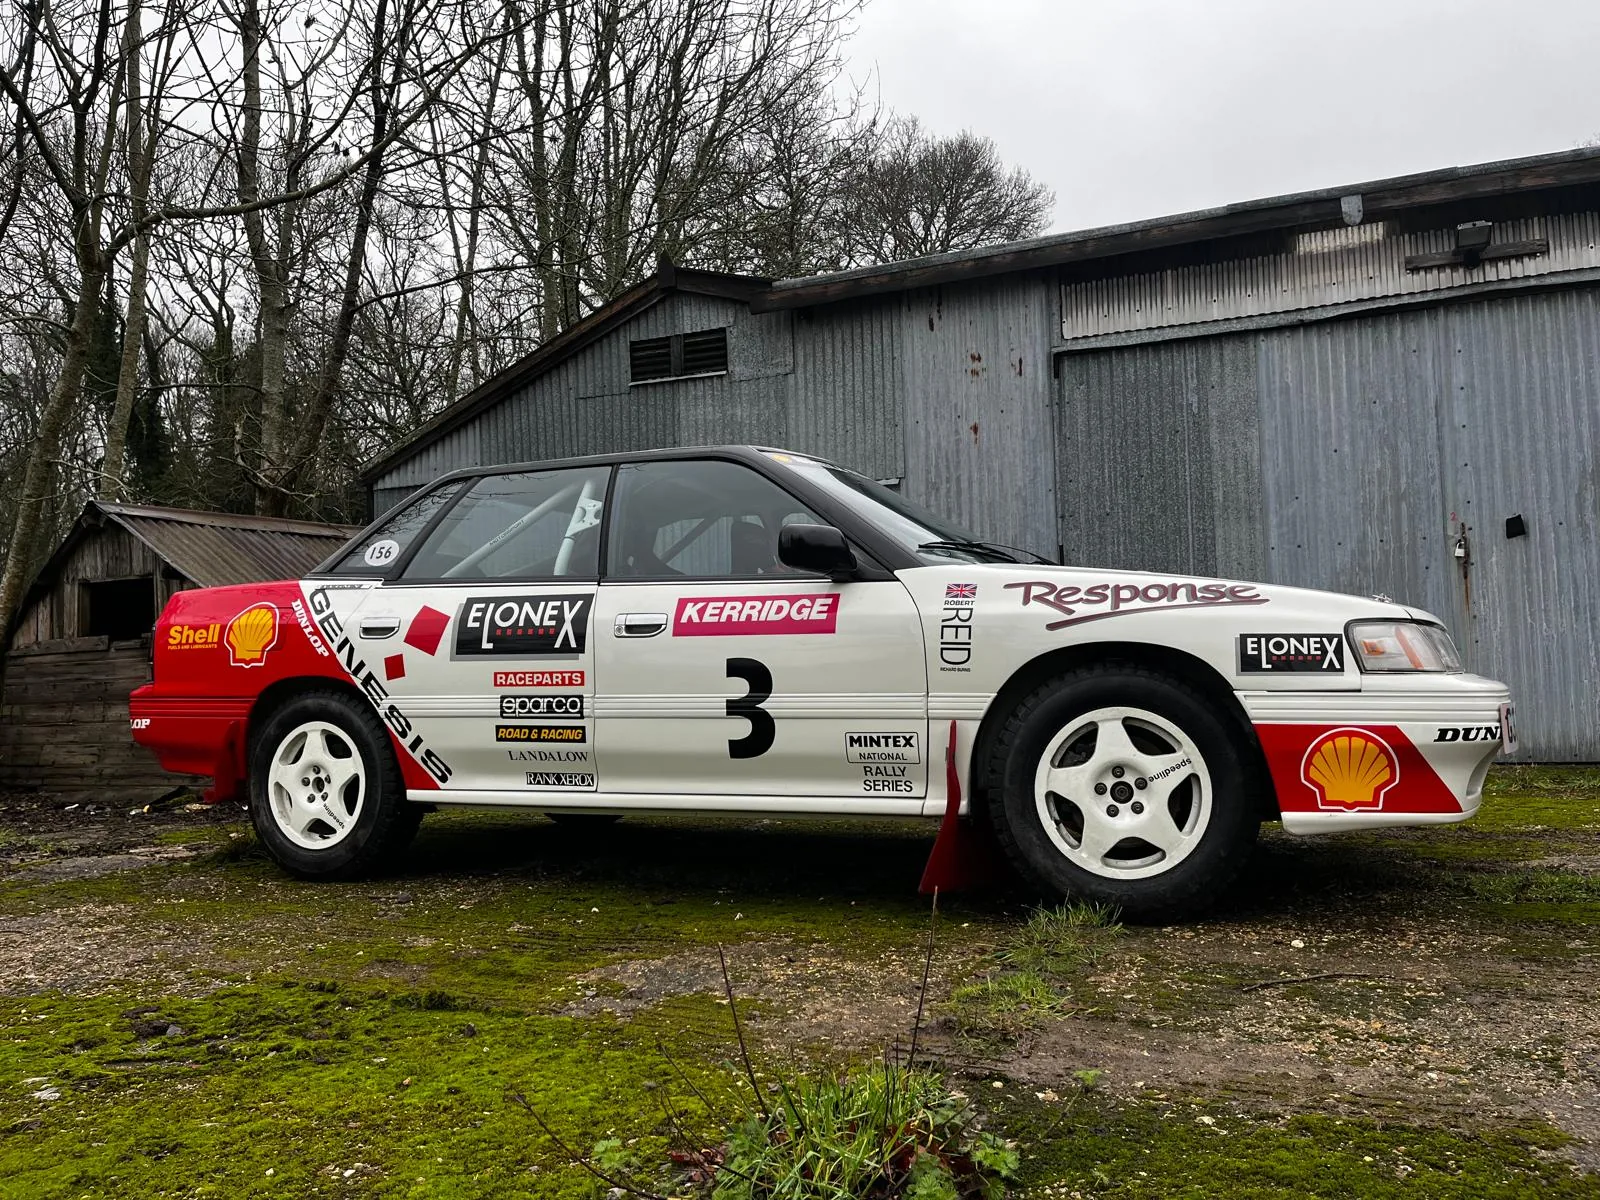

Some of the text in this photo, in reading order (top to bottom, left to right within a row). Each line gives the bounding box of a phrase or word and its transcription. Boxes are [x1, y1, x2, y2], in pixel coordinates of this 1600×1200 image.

[370, 546, 392, 560] 156
[1003, 581, 1262, 616] Response
[680, 598, 833, 623] KERRIDGE
[168, 624, 221, 644] Shell
[291, 599, 330, 657] DUNLOP
[466, 600, 584, 649] ELONEX
[940, 608, 973, 665] REID
[1246, 637, 1341, 669] ELONEX
[309, 589, 453, 784] GENESIS
[496, 673, 582, 685] RACEPARTS
[502, 697, 581, 717] sparco
[726, 657, 776, 759] 3
[498, 728, 583, 740] ROAD & RACING
[849, 735, 915, 748] MINTEX
[1433, 726, 1503, 743] DUN
[508, 751, 588, 762] LANDALOW
[859, 752, 908, 761] NATIONAL
[527, 773, 594, 786] RANK XEROX
[863, 766, 906, 777] RALLY
[1148, 758, 1192, 782] speedline
[863, 779, 913, 793] SERIES
